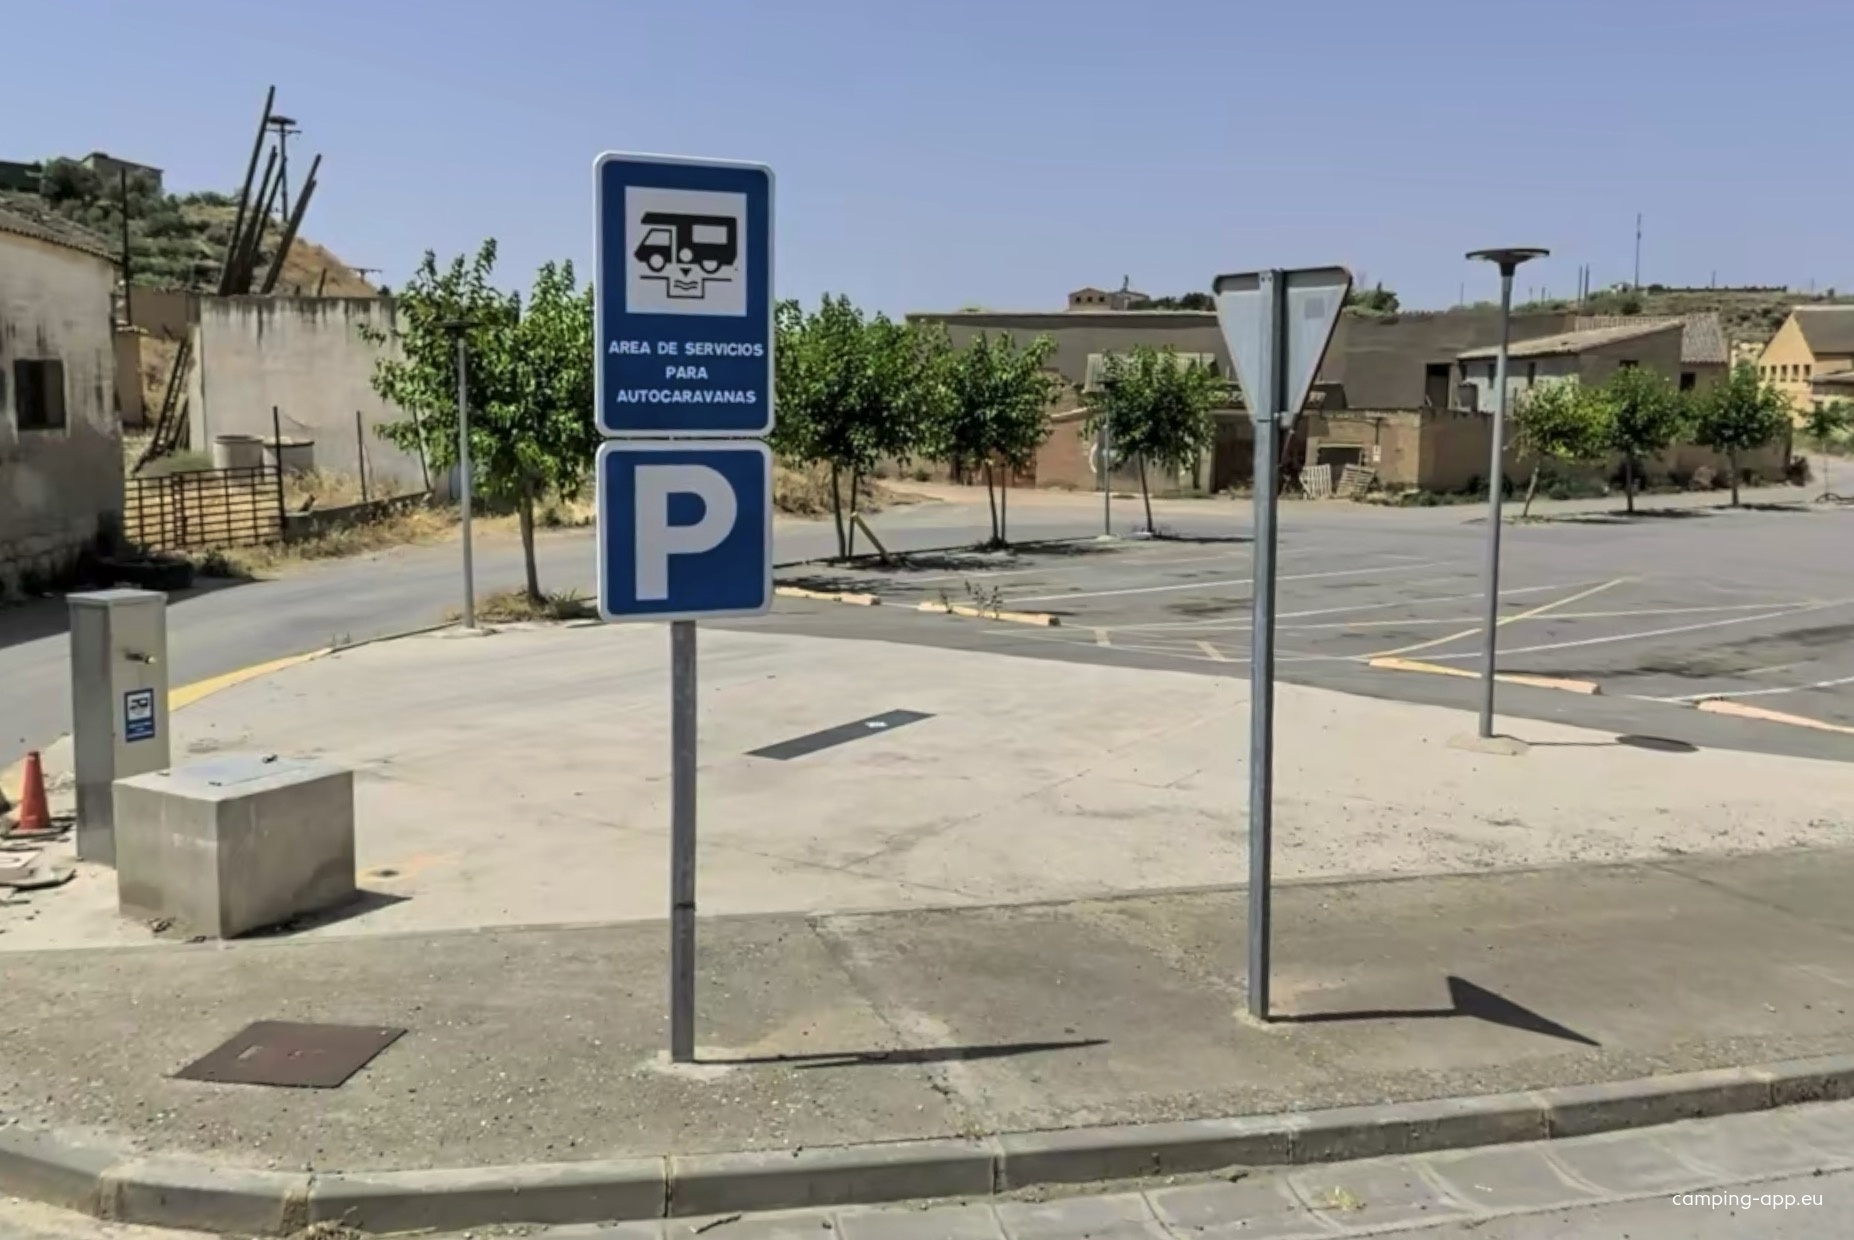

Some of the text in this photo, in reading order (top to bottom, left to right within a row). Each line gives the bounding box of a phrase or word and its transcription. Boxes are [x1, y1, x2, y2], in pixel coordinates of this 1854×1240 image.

[608, 340, 764, 357] AREA DE SERVICIOS
[665, 366, 708, 379] PARA
[617, 389, 757, 404] AUTOCARAVANAS
[635, 465, 737, 600] P
